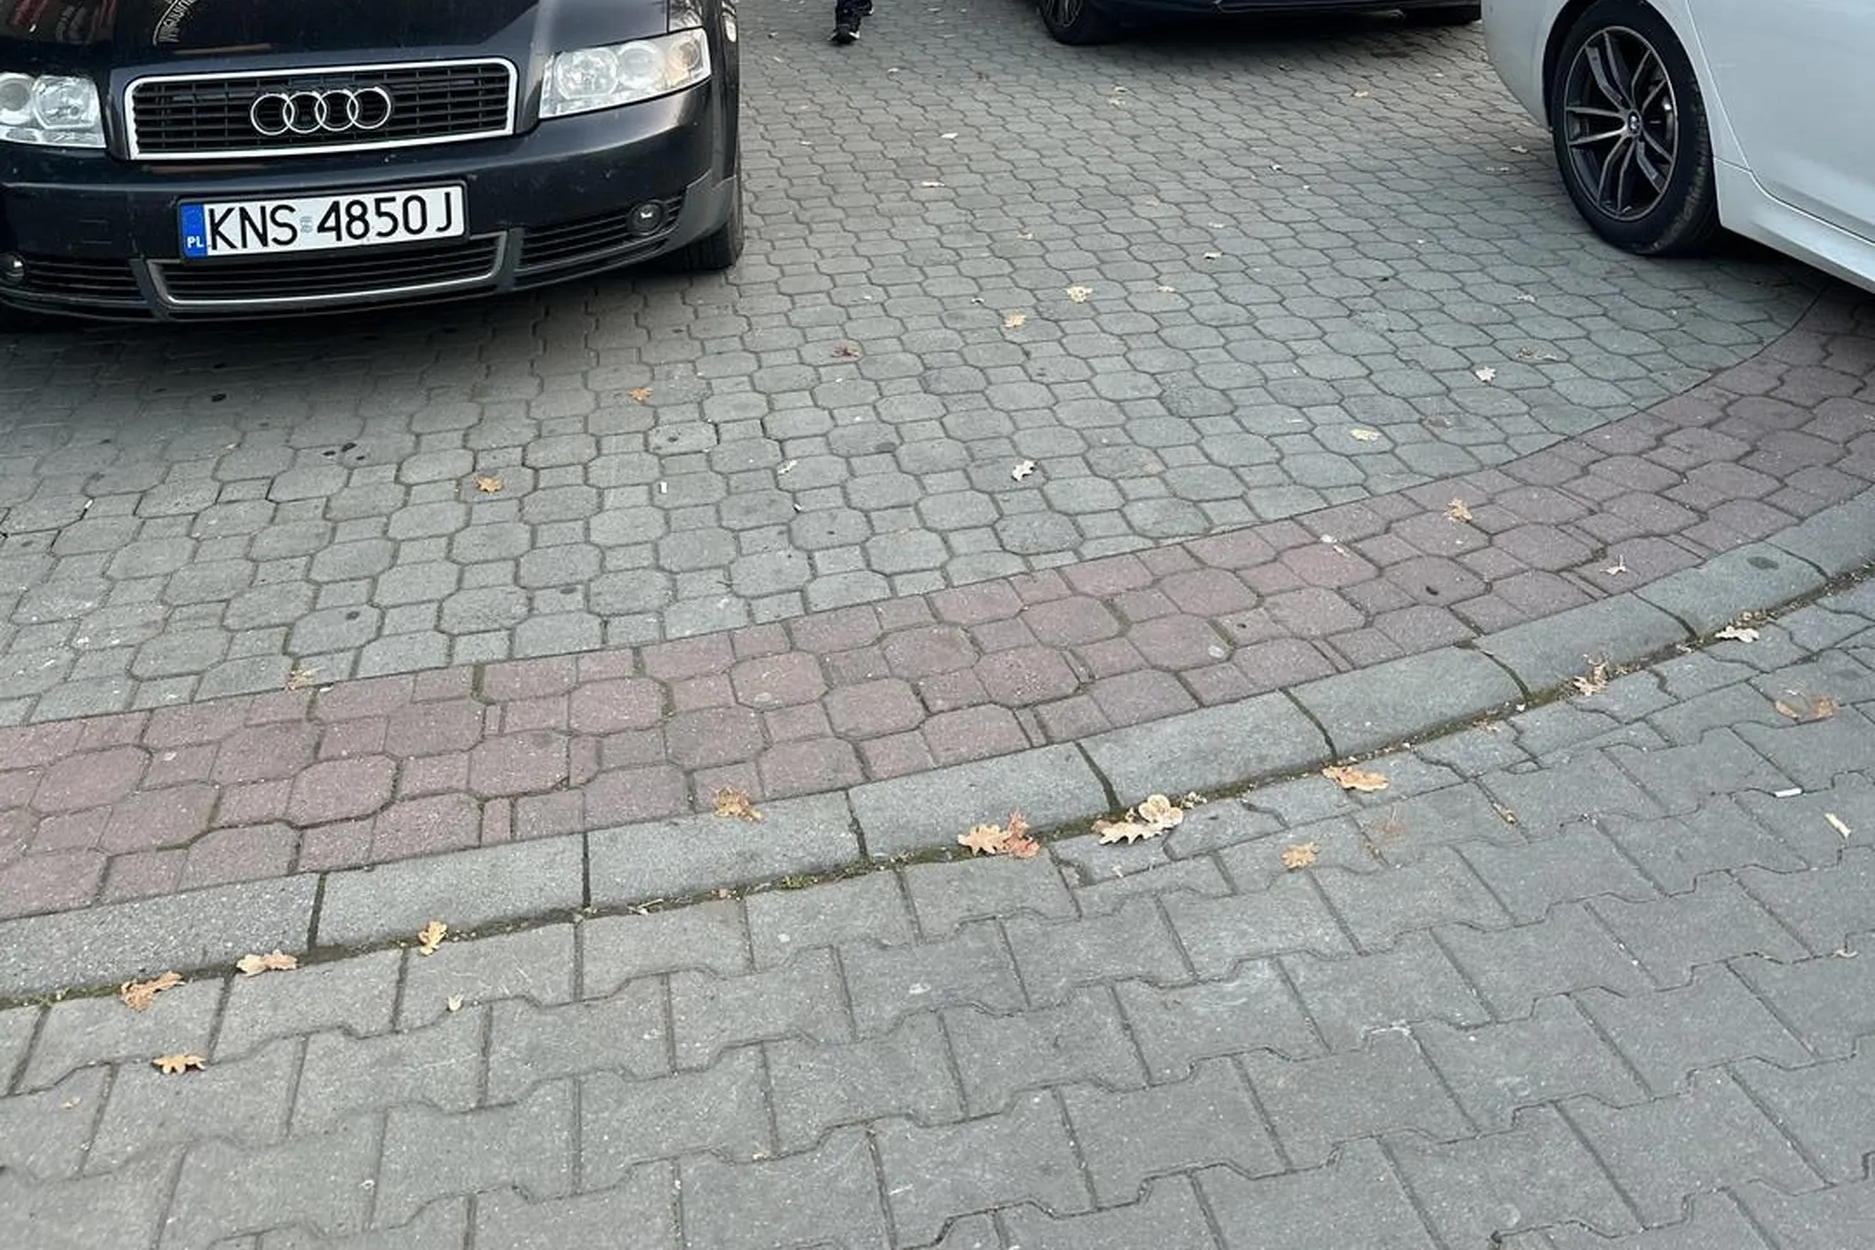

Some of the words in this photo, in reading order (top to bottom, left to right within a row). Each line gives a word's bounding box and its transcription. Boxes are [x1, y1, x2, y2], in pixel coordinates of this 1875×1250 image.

[208, 205, 298, 251] KNS
[317, 191, 453, 242] 4850J
[186, 236, 204, 249] PL
